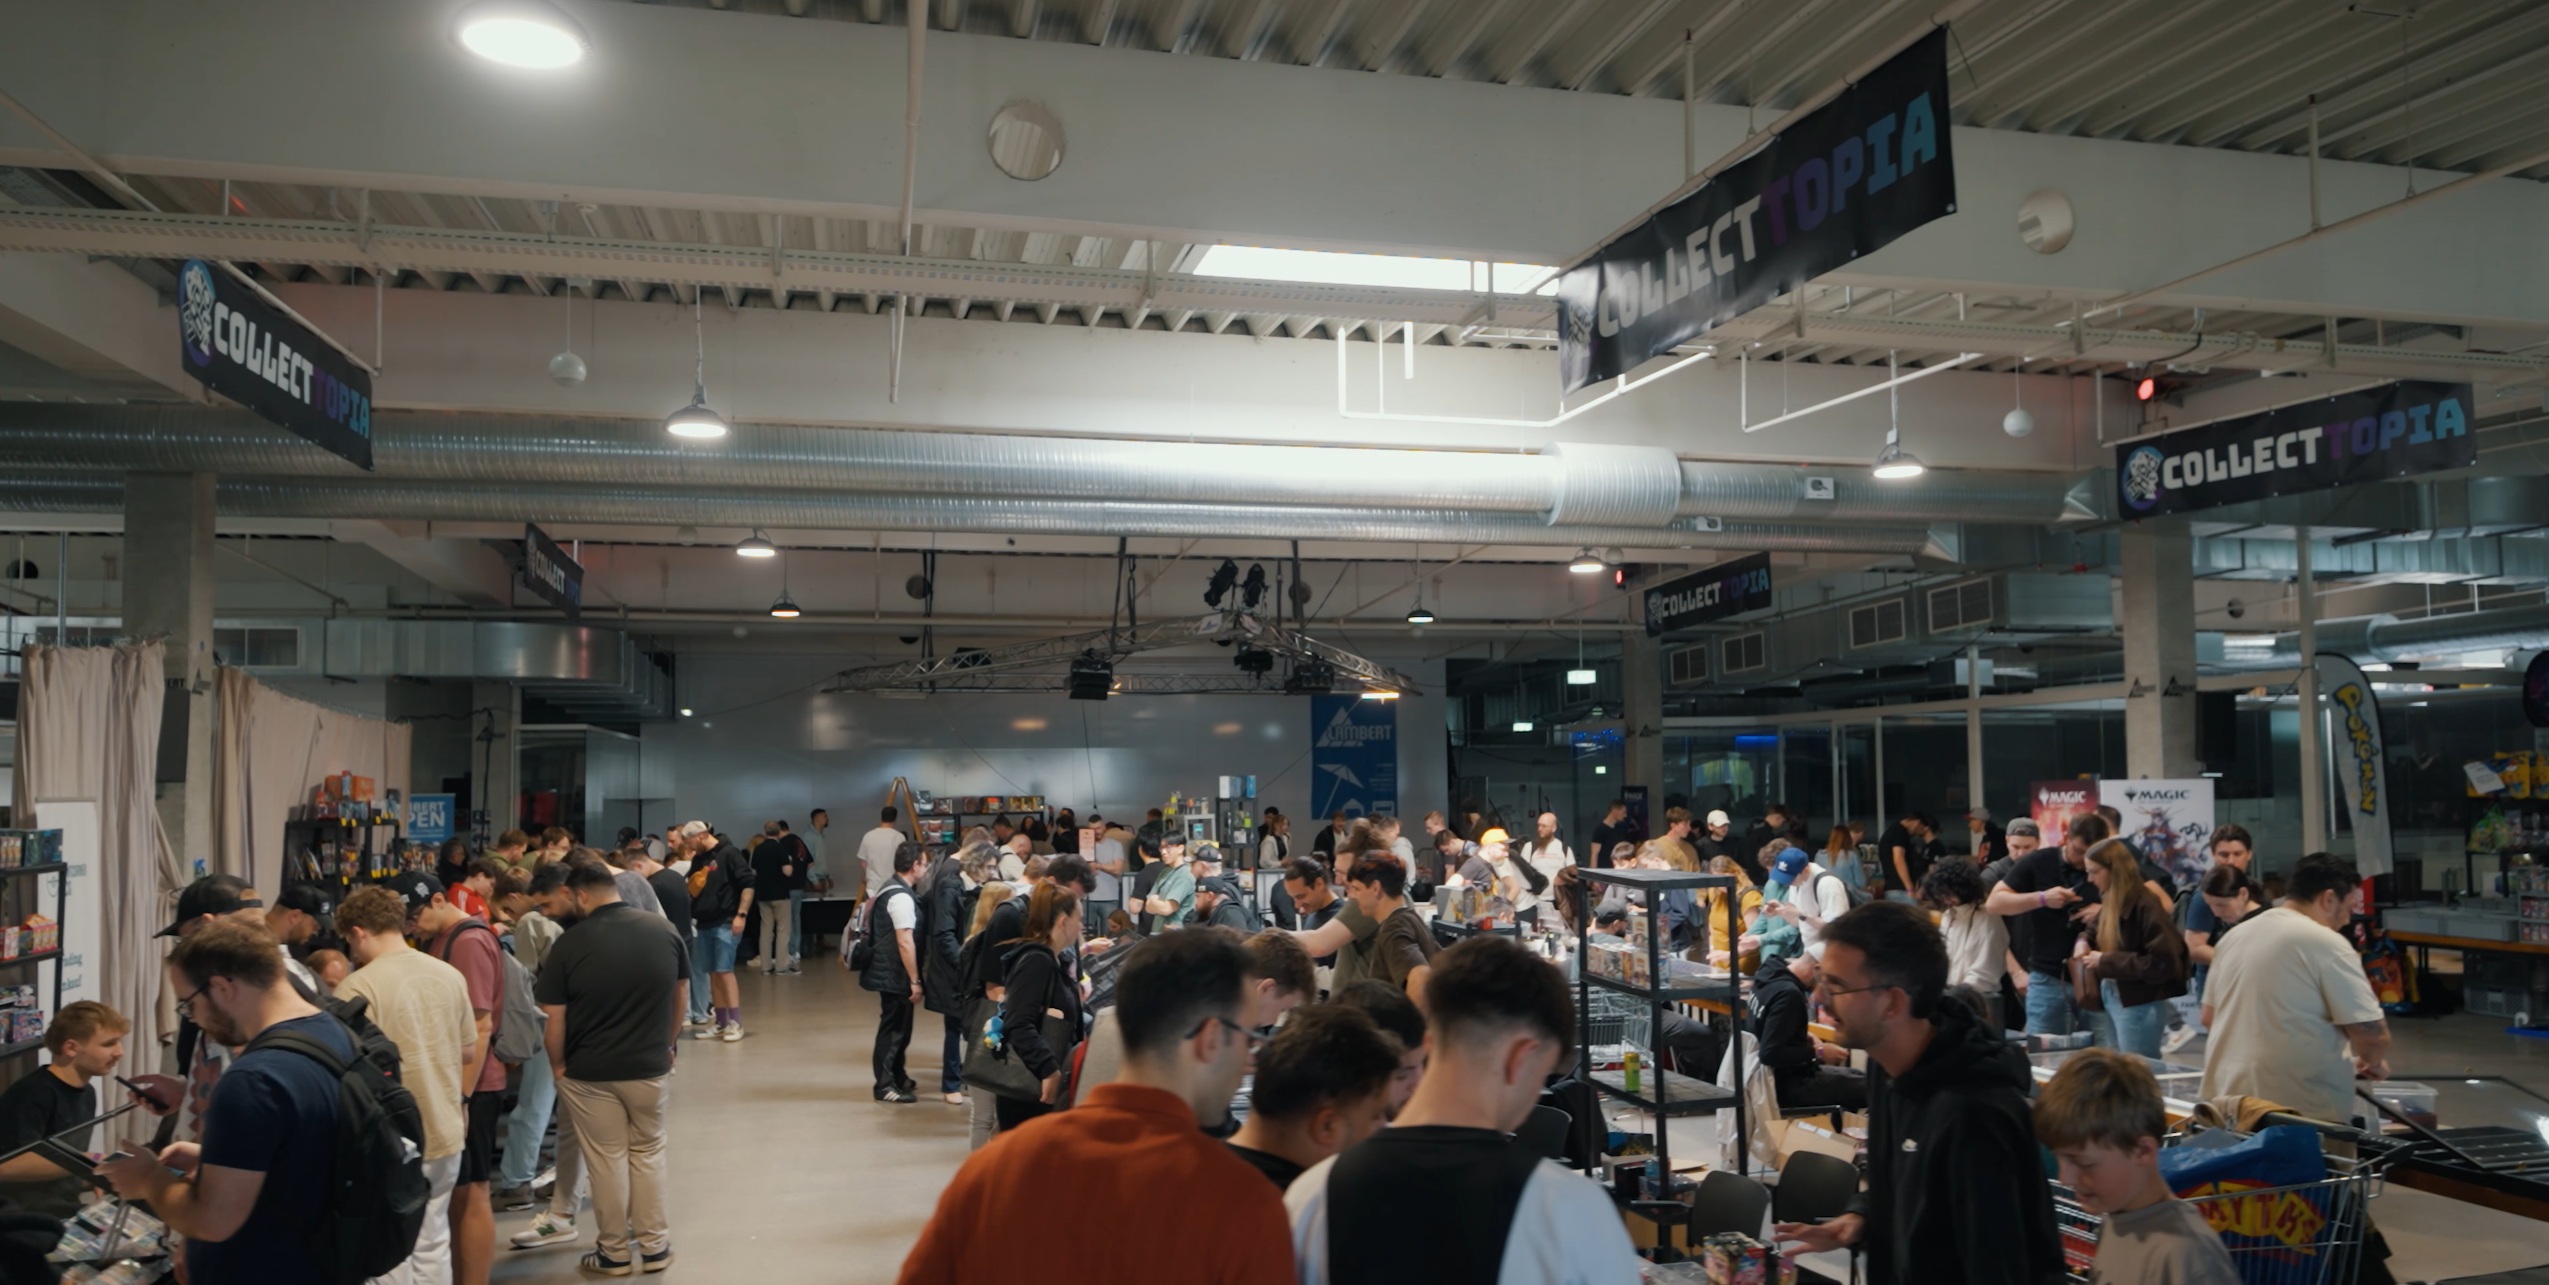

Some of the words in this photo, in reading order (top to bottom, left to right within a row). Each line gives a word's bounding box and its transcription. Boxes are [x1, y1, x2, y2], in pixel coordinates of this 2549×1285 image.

[1598, 91, 1937, 338] COLLECTTOPIA
[214, 301, 370, 439] COLLECTTOPIA
[2162, 398, 2466, 490] COLLECTTOPIA
[1328, 725, 1392, 740] LAMBERT
[2050, 790, 2087, 803] MAGIC
[2139, 789, 2191, 800] MAGIC
[409, 811, 446, 828] PEN
